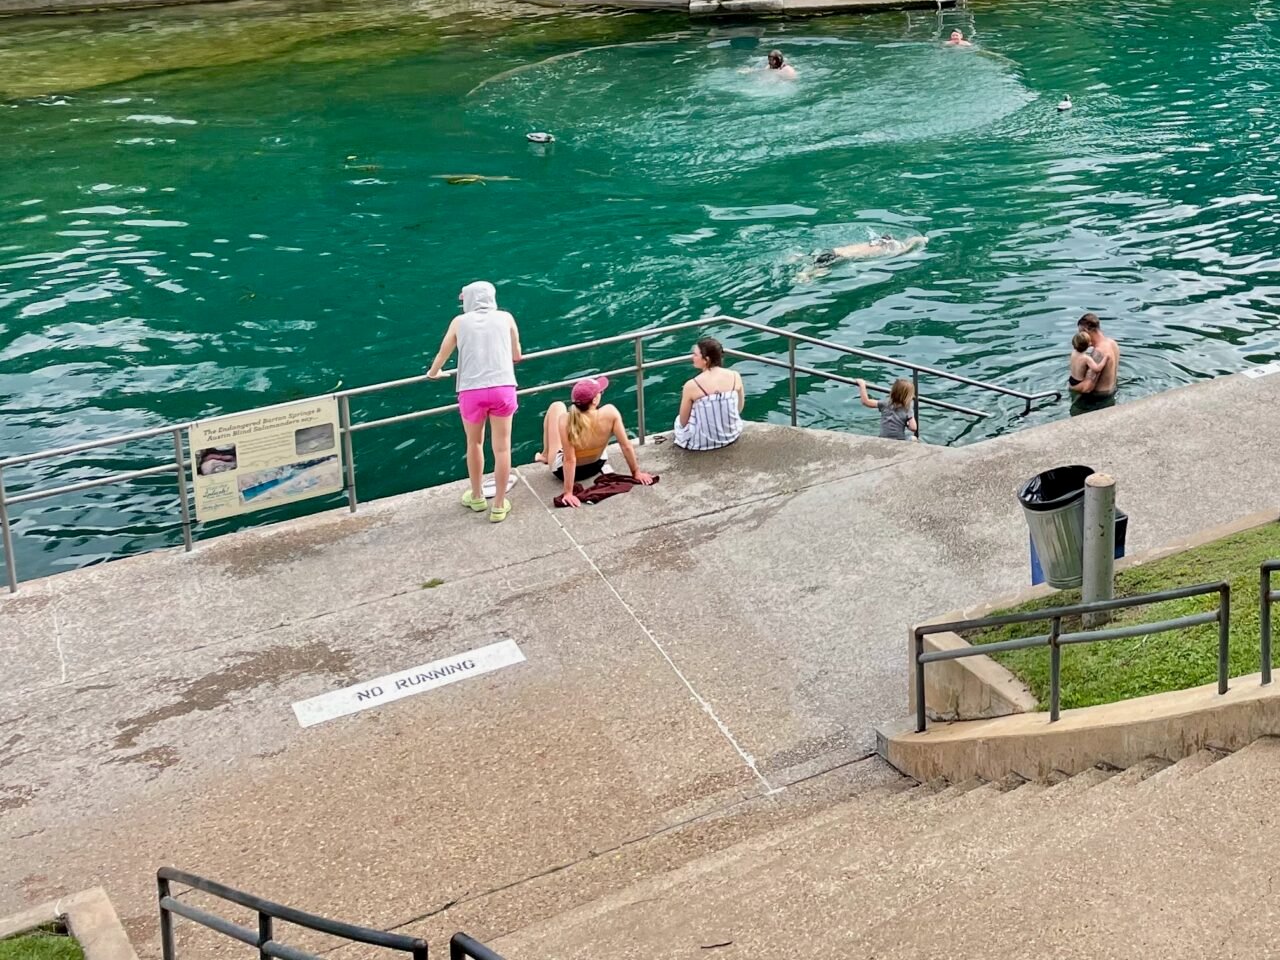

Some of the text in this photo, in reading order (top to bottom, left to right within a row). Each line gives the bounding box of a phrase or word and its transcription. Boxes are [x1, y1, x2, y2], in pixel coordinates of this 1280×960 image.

[206, 431, 231, 442] Austin
[232, 427, 252, 437] Blind
[253, 418, 300, 433] Salamanders
[218, 418, 262, 433] Endangered
[262, 415, 287, 425] Barton
[288, 409, 316, 421] Springs
[357, 659, 476, 701] NO RUNNING
